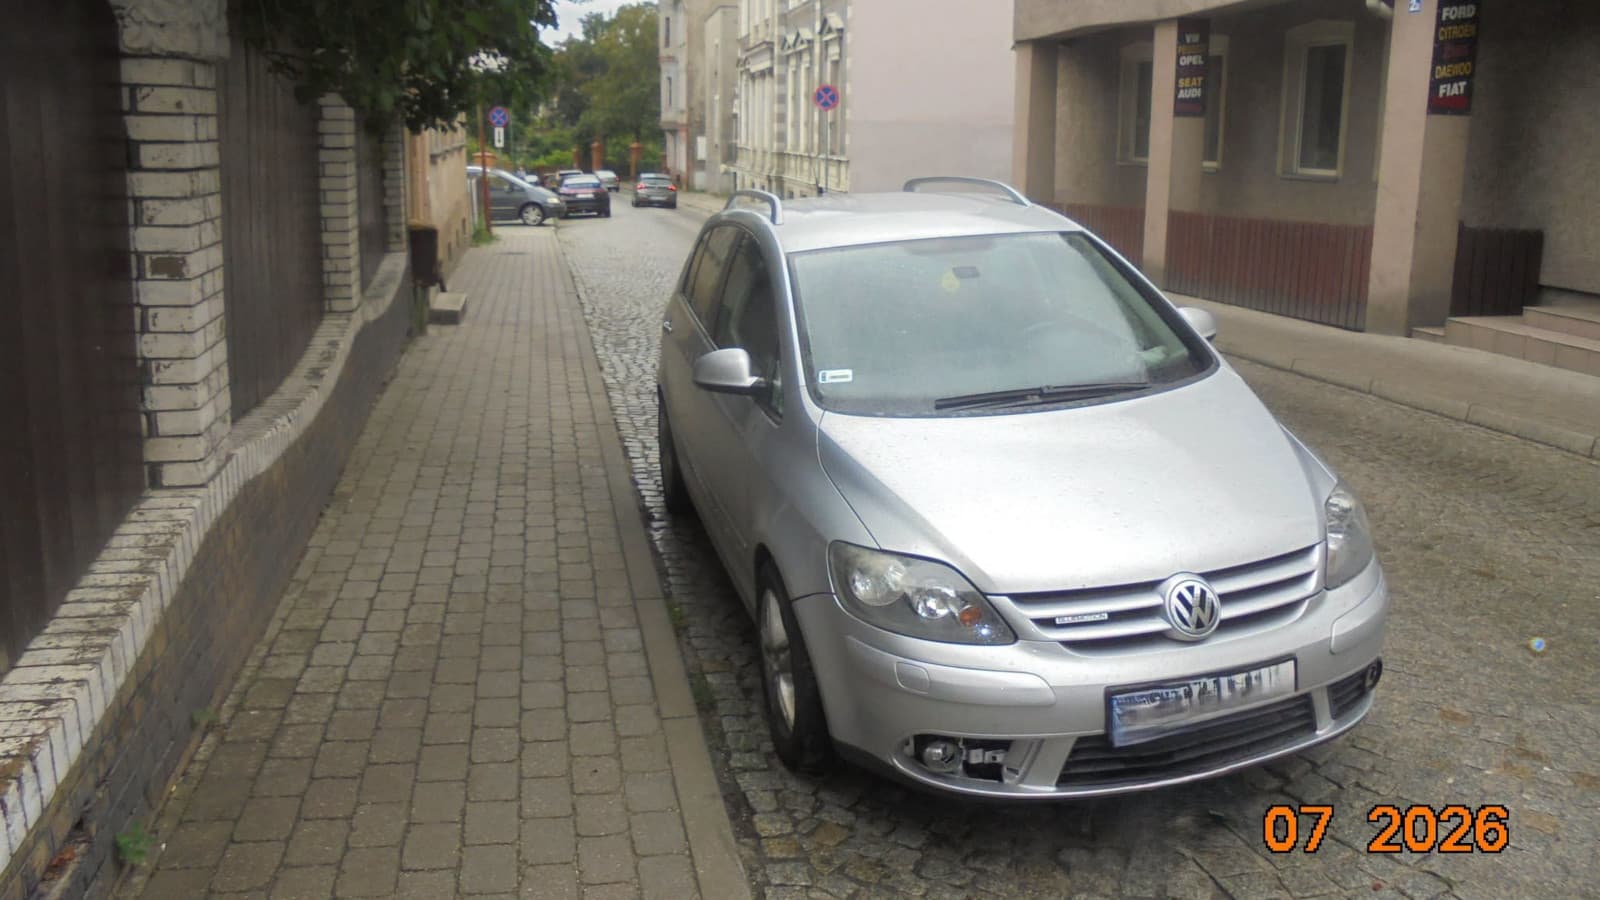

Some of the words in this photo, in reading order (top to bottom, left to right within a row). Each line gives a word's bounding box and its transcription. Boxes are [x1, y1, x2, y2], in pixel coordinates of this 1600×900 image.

[1441, 4, 1476, 21] FORD
[1179, 55, 1204, 66] OPEL
[1435, 62, 1472, 79] DAEWOO
[1178, 76, 1204, 88] SEAT
[1438, 81, 1467, 98] FIAT
[1177, 88, 1202, 99] AUDI
[1170, 580, 1219, 634] VW
